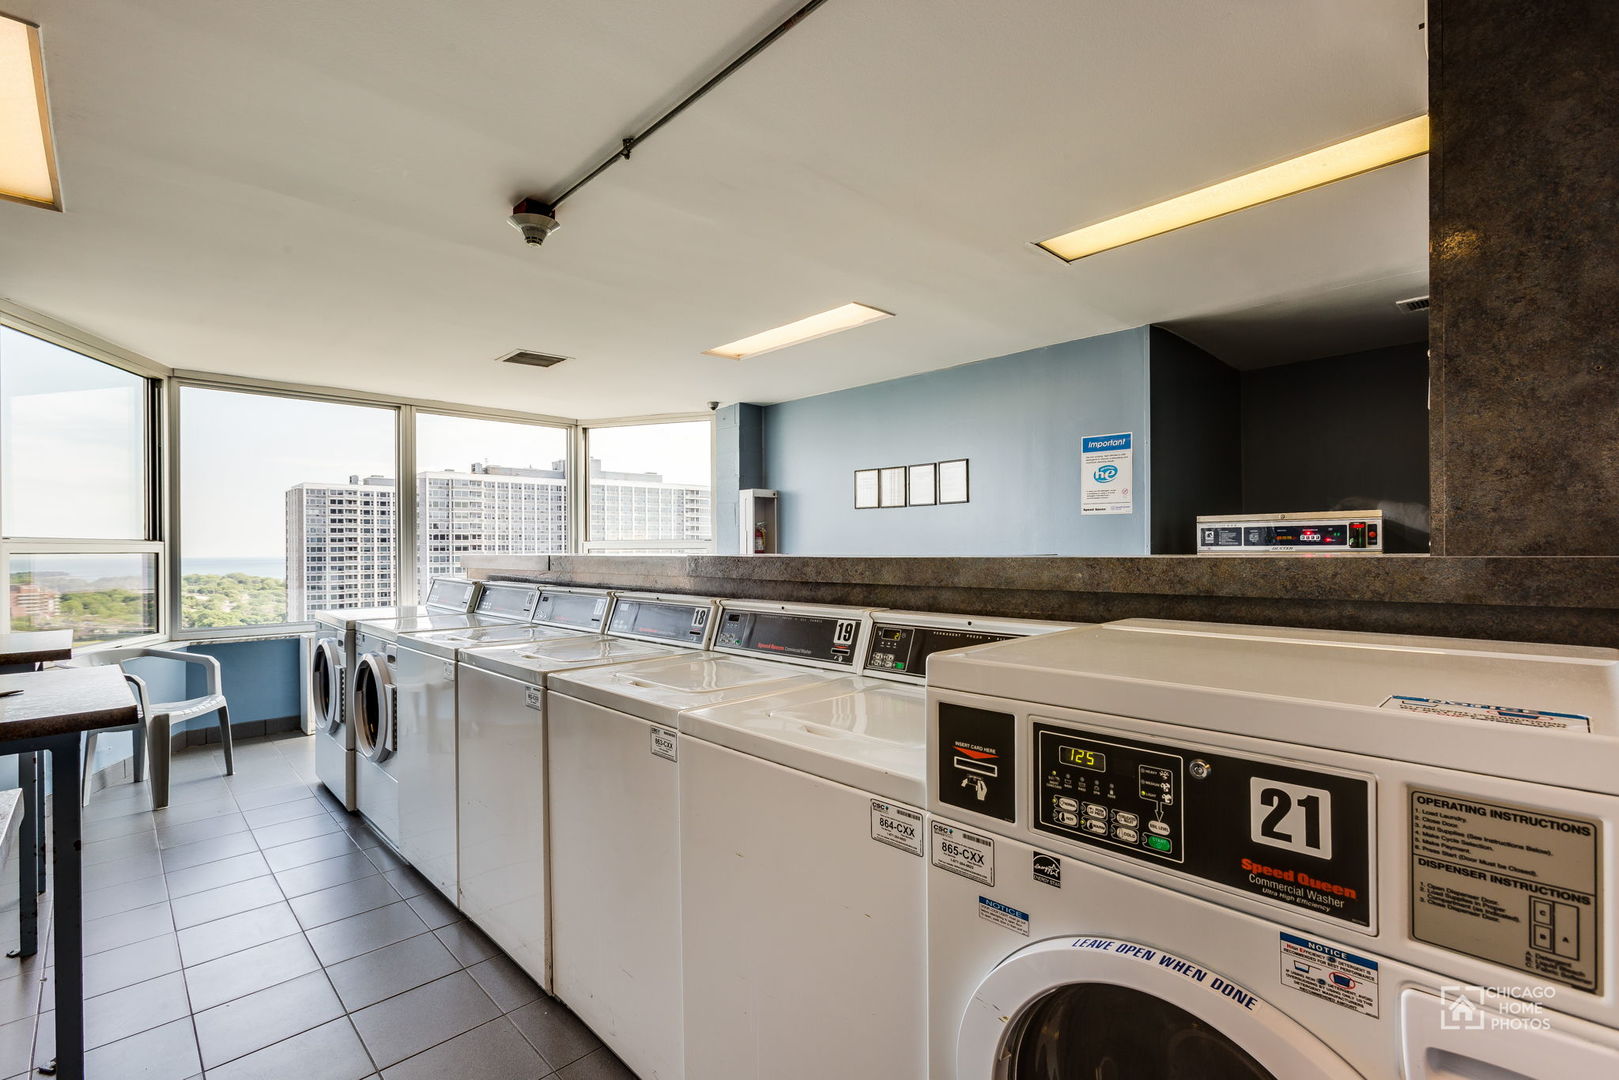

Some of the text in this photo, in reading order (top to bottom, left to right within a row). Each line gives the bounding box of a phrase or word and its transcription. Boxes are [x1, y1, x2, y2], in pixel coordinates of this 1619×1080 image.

[1088, 438, 1126, 448] Important
[694, 610, 706, 625] 18
[838, 623, 854, 641] 19
[1070, 748, 1094, 765] 125
[872, 802, 884, 810] CSC
[1417, 795, 1591, 837] OPERATING INSTRUCTIONS
[880, 818, 915, 838] 864-CXX
[934, 824, 949, 834] CSC
[1260, 788, 1320, 850] 21
[942, 842, 984, 866] 865-CXX
[1241, 858, 1357, 900] Speed Queen
[1418, 857, 1591, 906] DISPENSER INSTRUCTIONS
[1248, 874, 1344, 908] Commercial Washer
[1262, 888, 1330, 912] Ultra High Efficiency
[986, 900, 1022, 917] NOTICE
[1308, 942, 1347, 959] NOTICE
[1072, 938, 1258, 1011] LEAVE OPEN WHEN DONE
